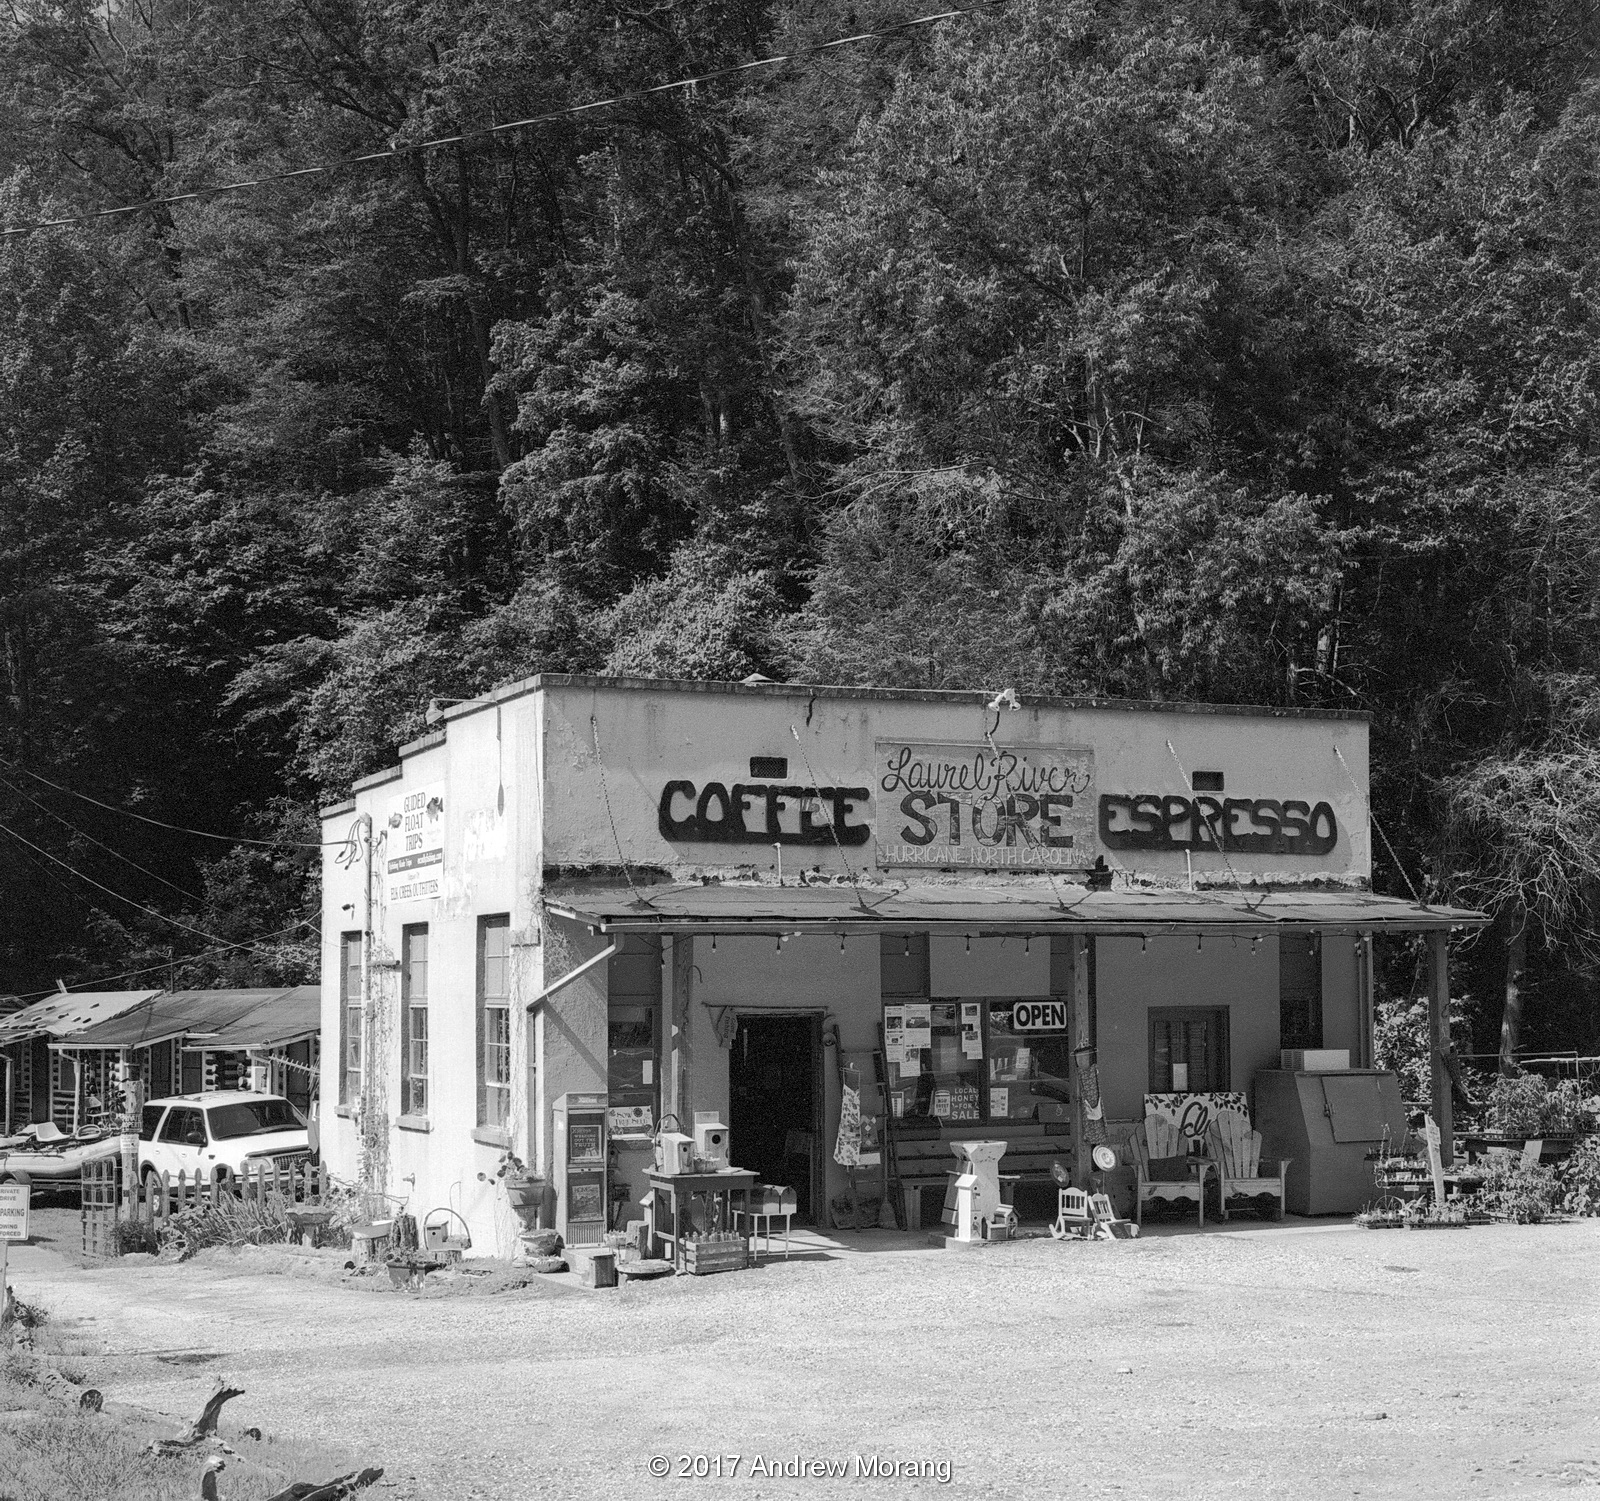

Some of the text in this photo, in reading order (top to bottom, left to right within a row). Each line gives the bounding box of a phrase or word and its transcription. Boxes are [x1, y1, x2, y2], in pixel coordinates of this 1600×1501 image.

[881, 747, 1091, 800] Laurel River
[404, 792, 425, 813] GUIDED
[658, 780, 871, 847] COFFEE
[405, 812, 424, 832] FLOAT
[900, 790, 1074, 849] STORE
[1098, 794, 1338, 855] ESPRESSO
[406, 832, 423, 851] TRIPS
[971, 846, 1017, 864] NORTH
[1021, 847, 1088, 864] CAROLINA
[1015, 1004, 1065, 1027] OPEN
[951, 1110, 980, 1120] SALE
